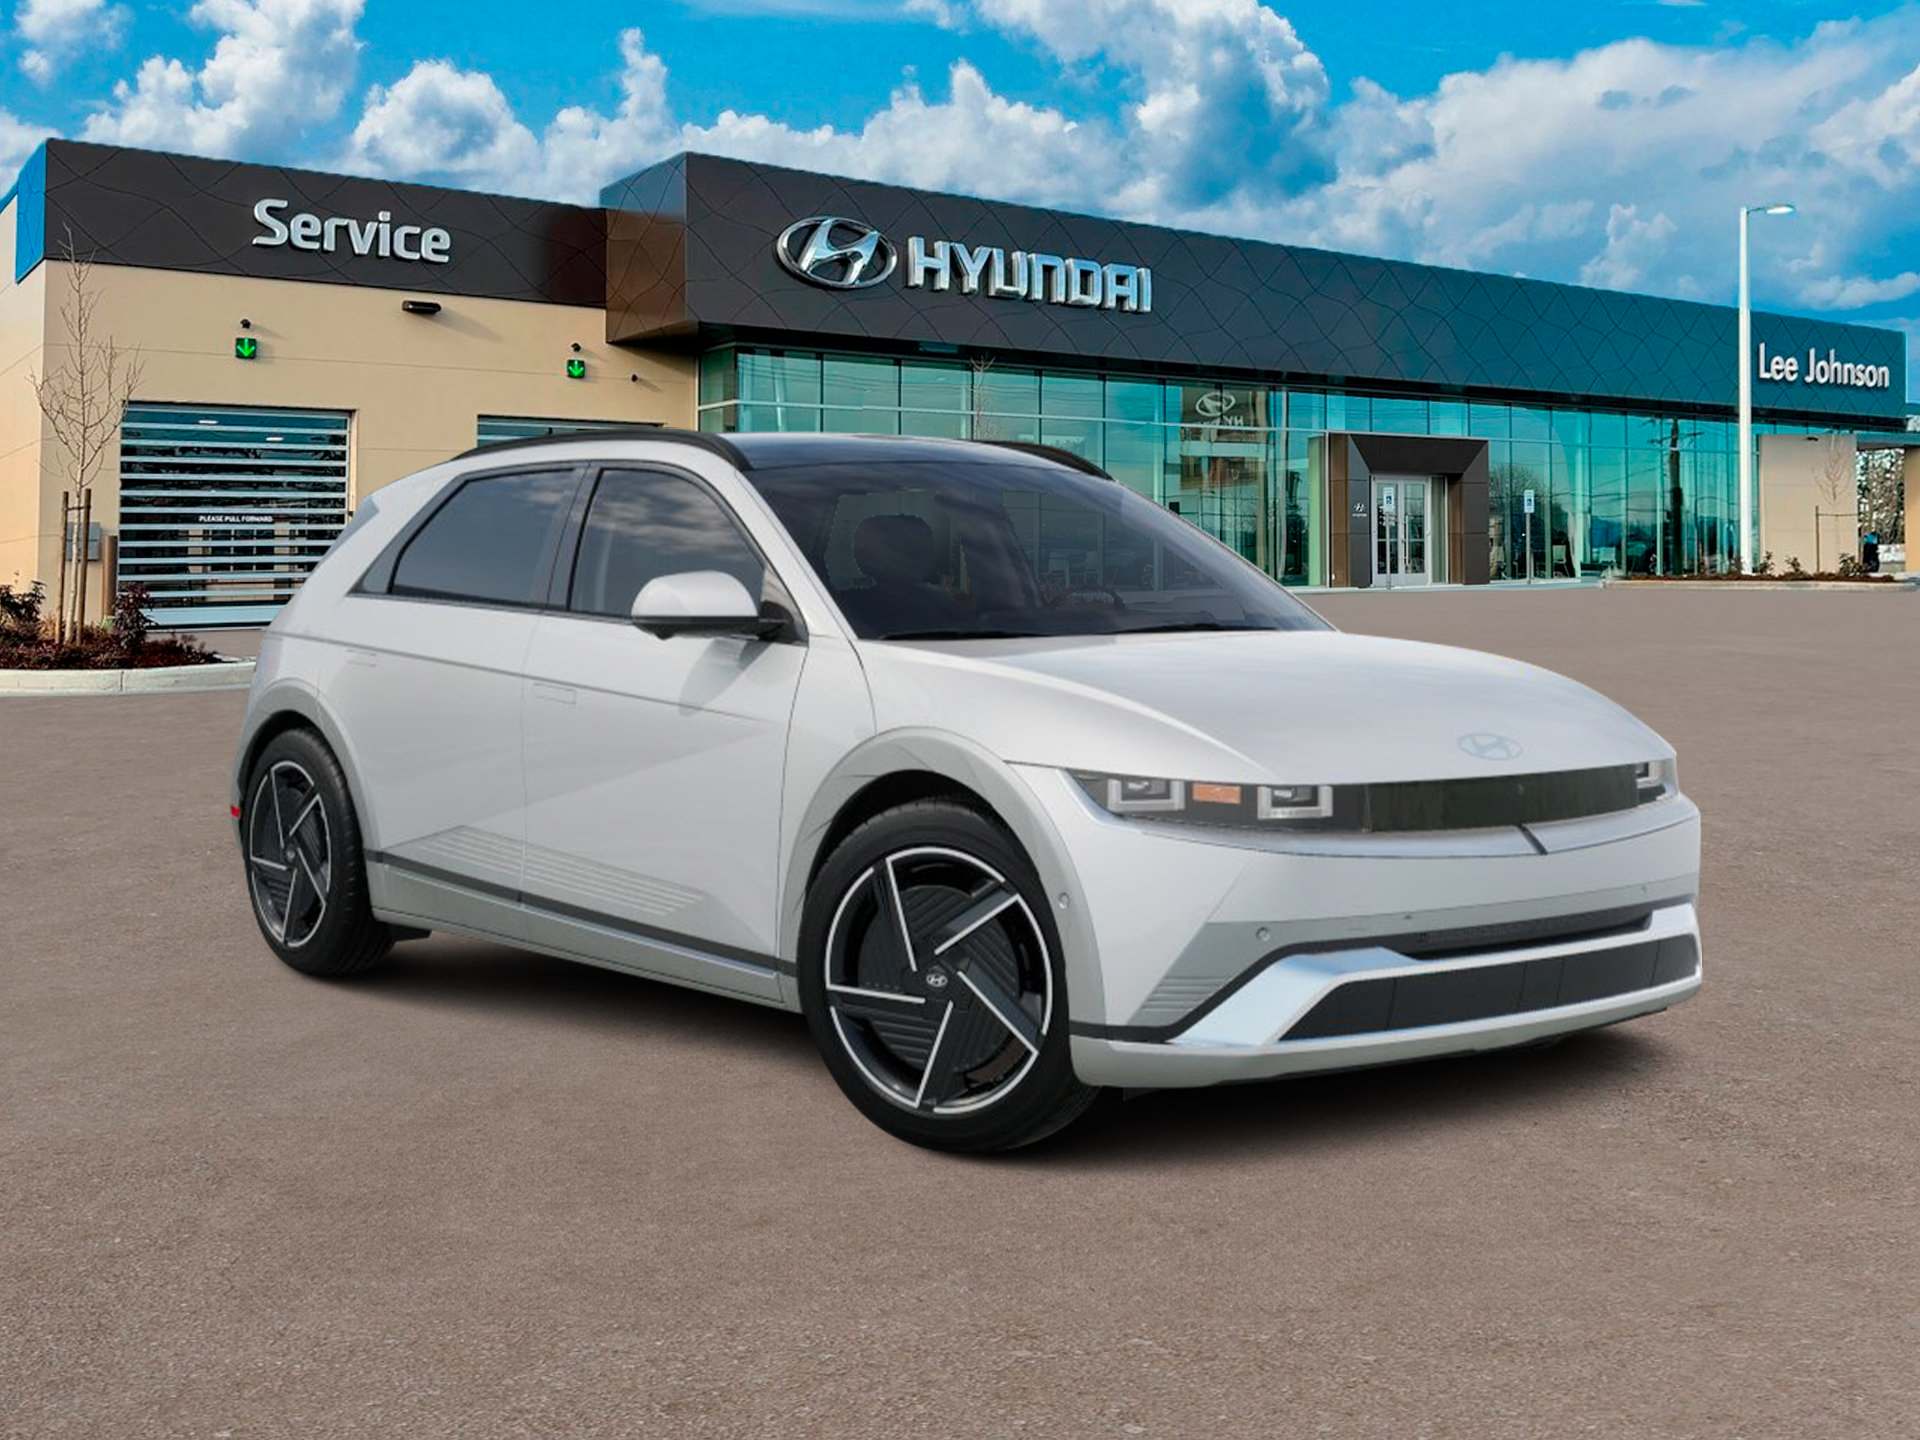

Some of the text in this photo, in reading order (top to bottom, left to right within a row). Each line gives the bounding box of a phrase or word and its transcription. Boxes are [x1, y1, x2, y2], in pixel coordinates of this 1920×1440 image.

[252, 198, 451, 263] Service
[907, 236, 1153, 313] HYUNDAI
[1759, 342, 1890, 388] Lee Johnson
[198, 515, 274, 523] PLEASE PULL FORWARD
